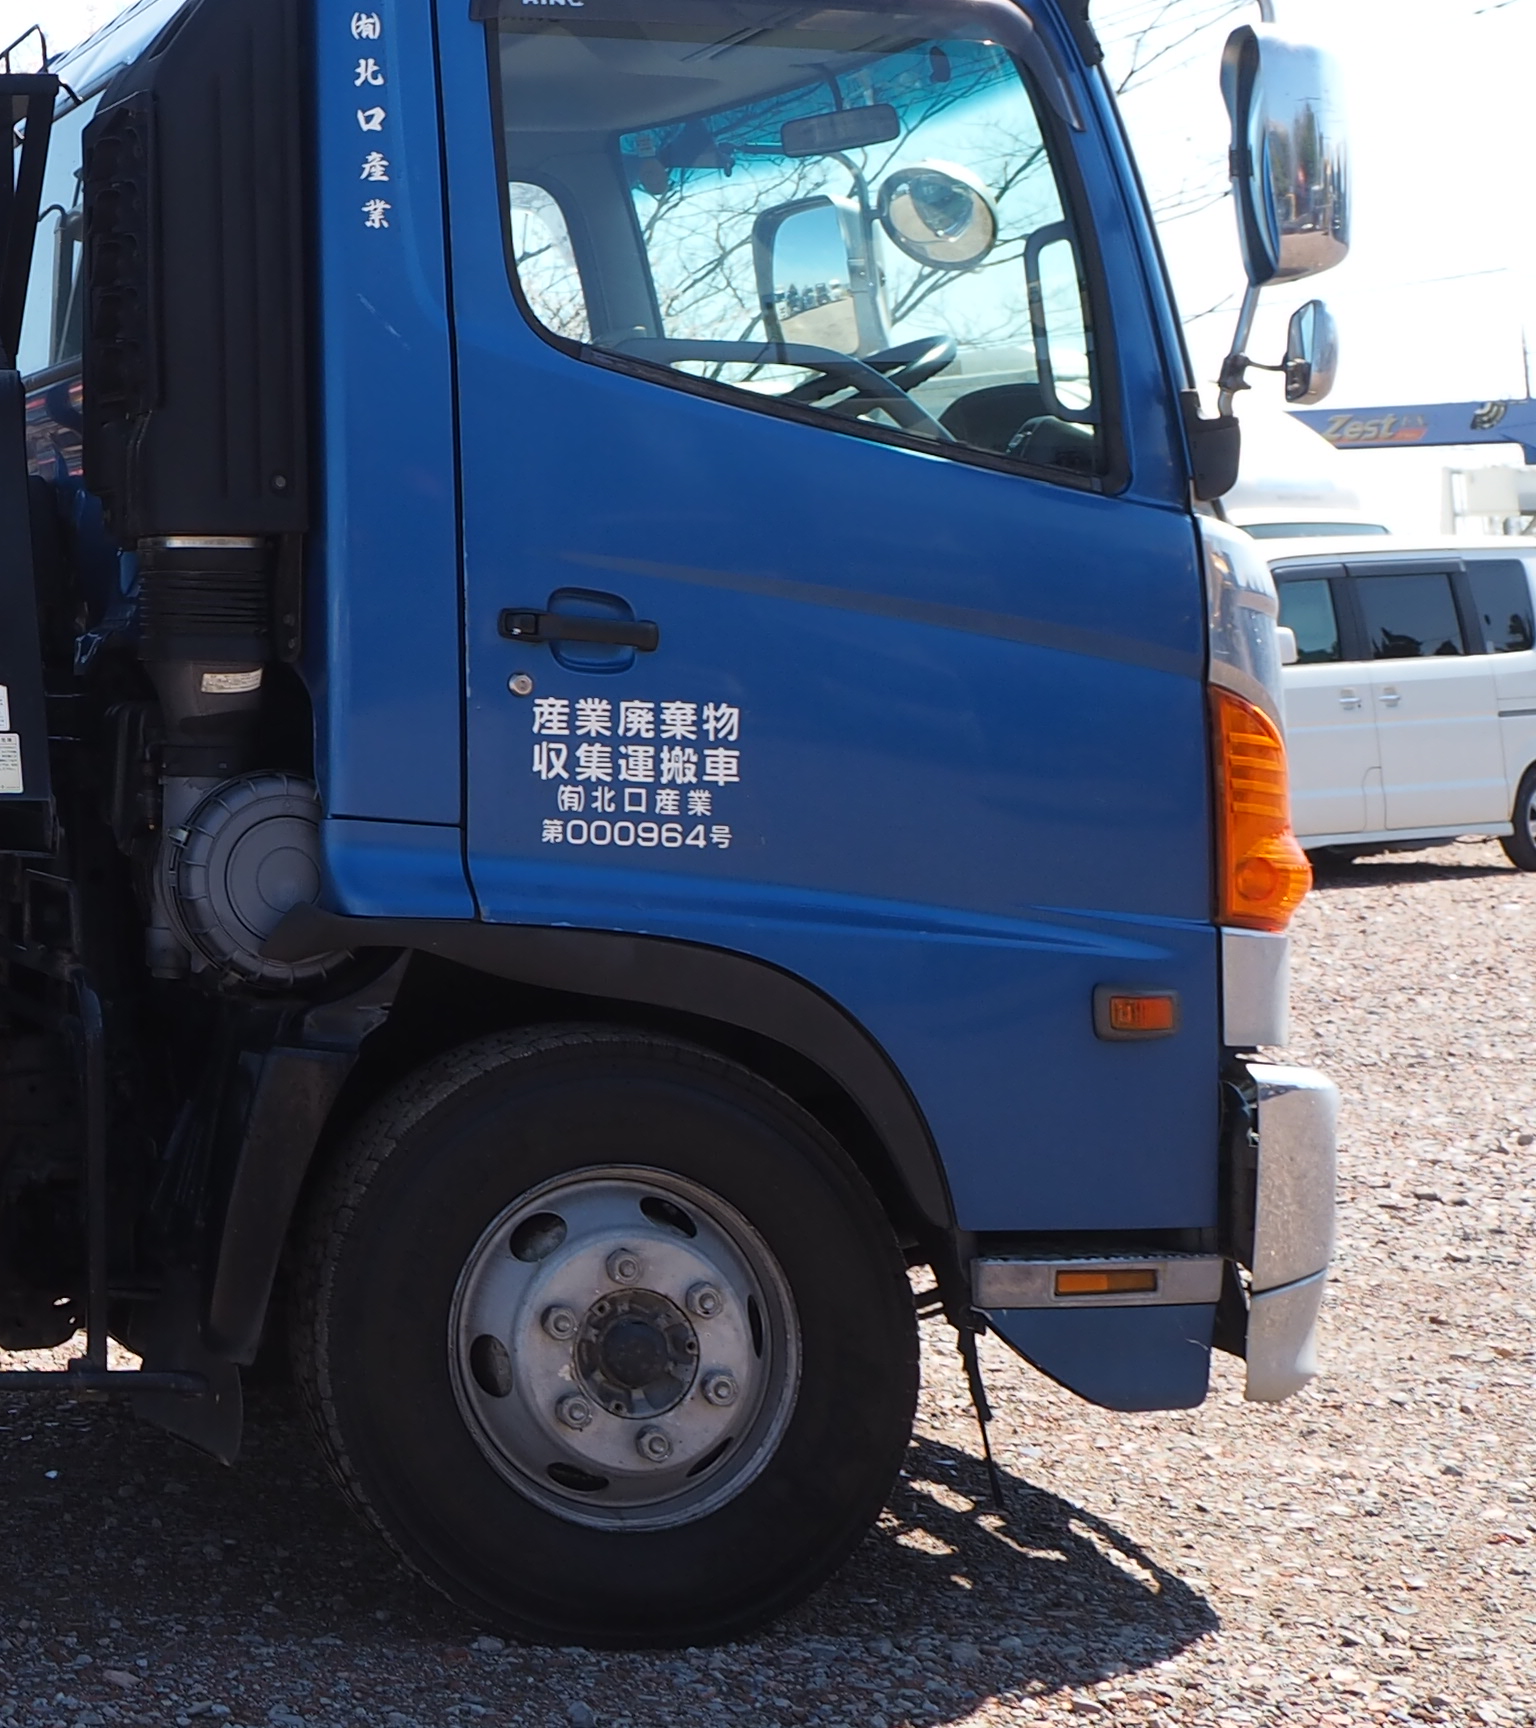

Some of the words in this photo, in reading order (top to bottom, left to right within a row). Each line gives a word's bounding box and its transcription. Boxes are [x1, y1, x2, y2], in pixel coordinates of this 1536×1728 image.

[532, 697, 739, 741] 産業廃棄物
[532, 741, 740, 786] 収集運搬車
[541, 819, 732, 849] 第000964号
